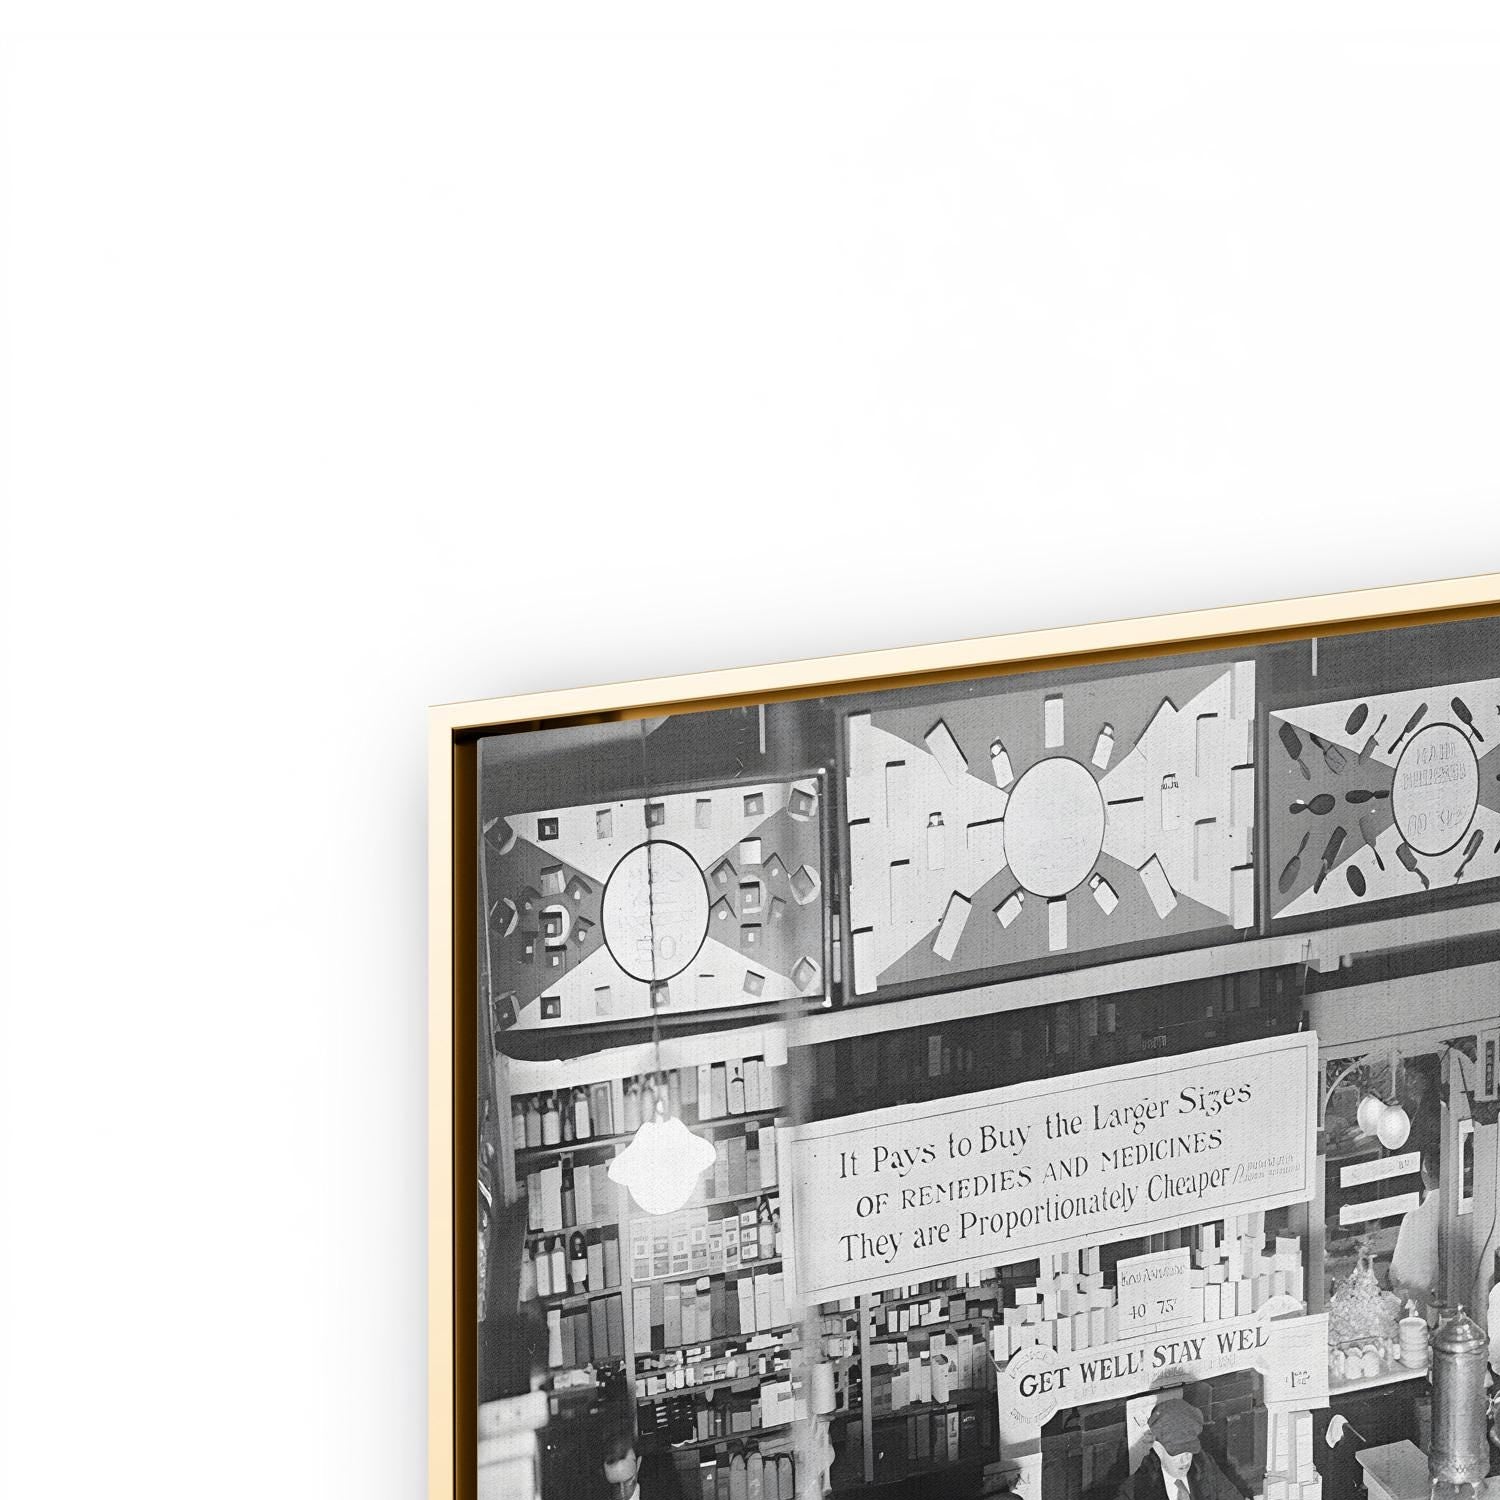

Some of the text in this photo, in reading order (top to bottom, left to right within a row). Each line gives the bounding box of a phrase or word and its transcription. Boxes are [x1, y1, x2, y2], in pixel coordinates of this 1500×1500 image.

[839, 1083, 1252, 1178] It Pays to Buy the Larger Sizes
[856, 1193, 889, 1218] OF
[901, 1166, 1033, 1209] REMEDIES
[1042, 1156, 1088, 1184] AND
[1101, 1129, 1222, 1172] MEDICINES
[838, 1231, 903, 1264] They
[913, 1222, 950, 1249] are
[959, 1182, 1139, 1240] Proportionately
[1147, 1166, 1231, 1202] Cheaper
[1019, 1366, 1070, 1397] GET
[1080, 1349, 1144, 1383] WELL!
[1152, 1337, 1206, 1368] STAY
[1216, 1326, 1270, 1354] WEL
